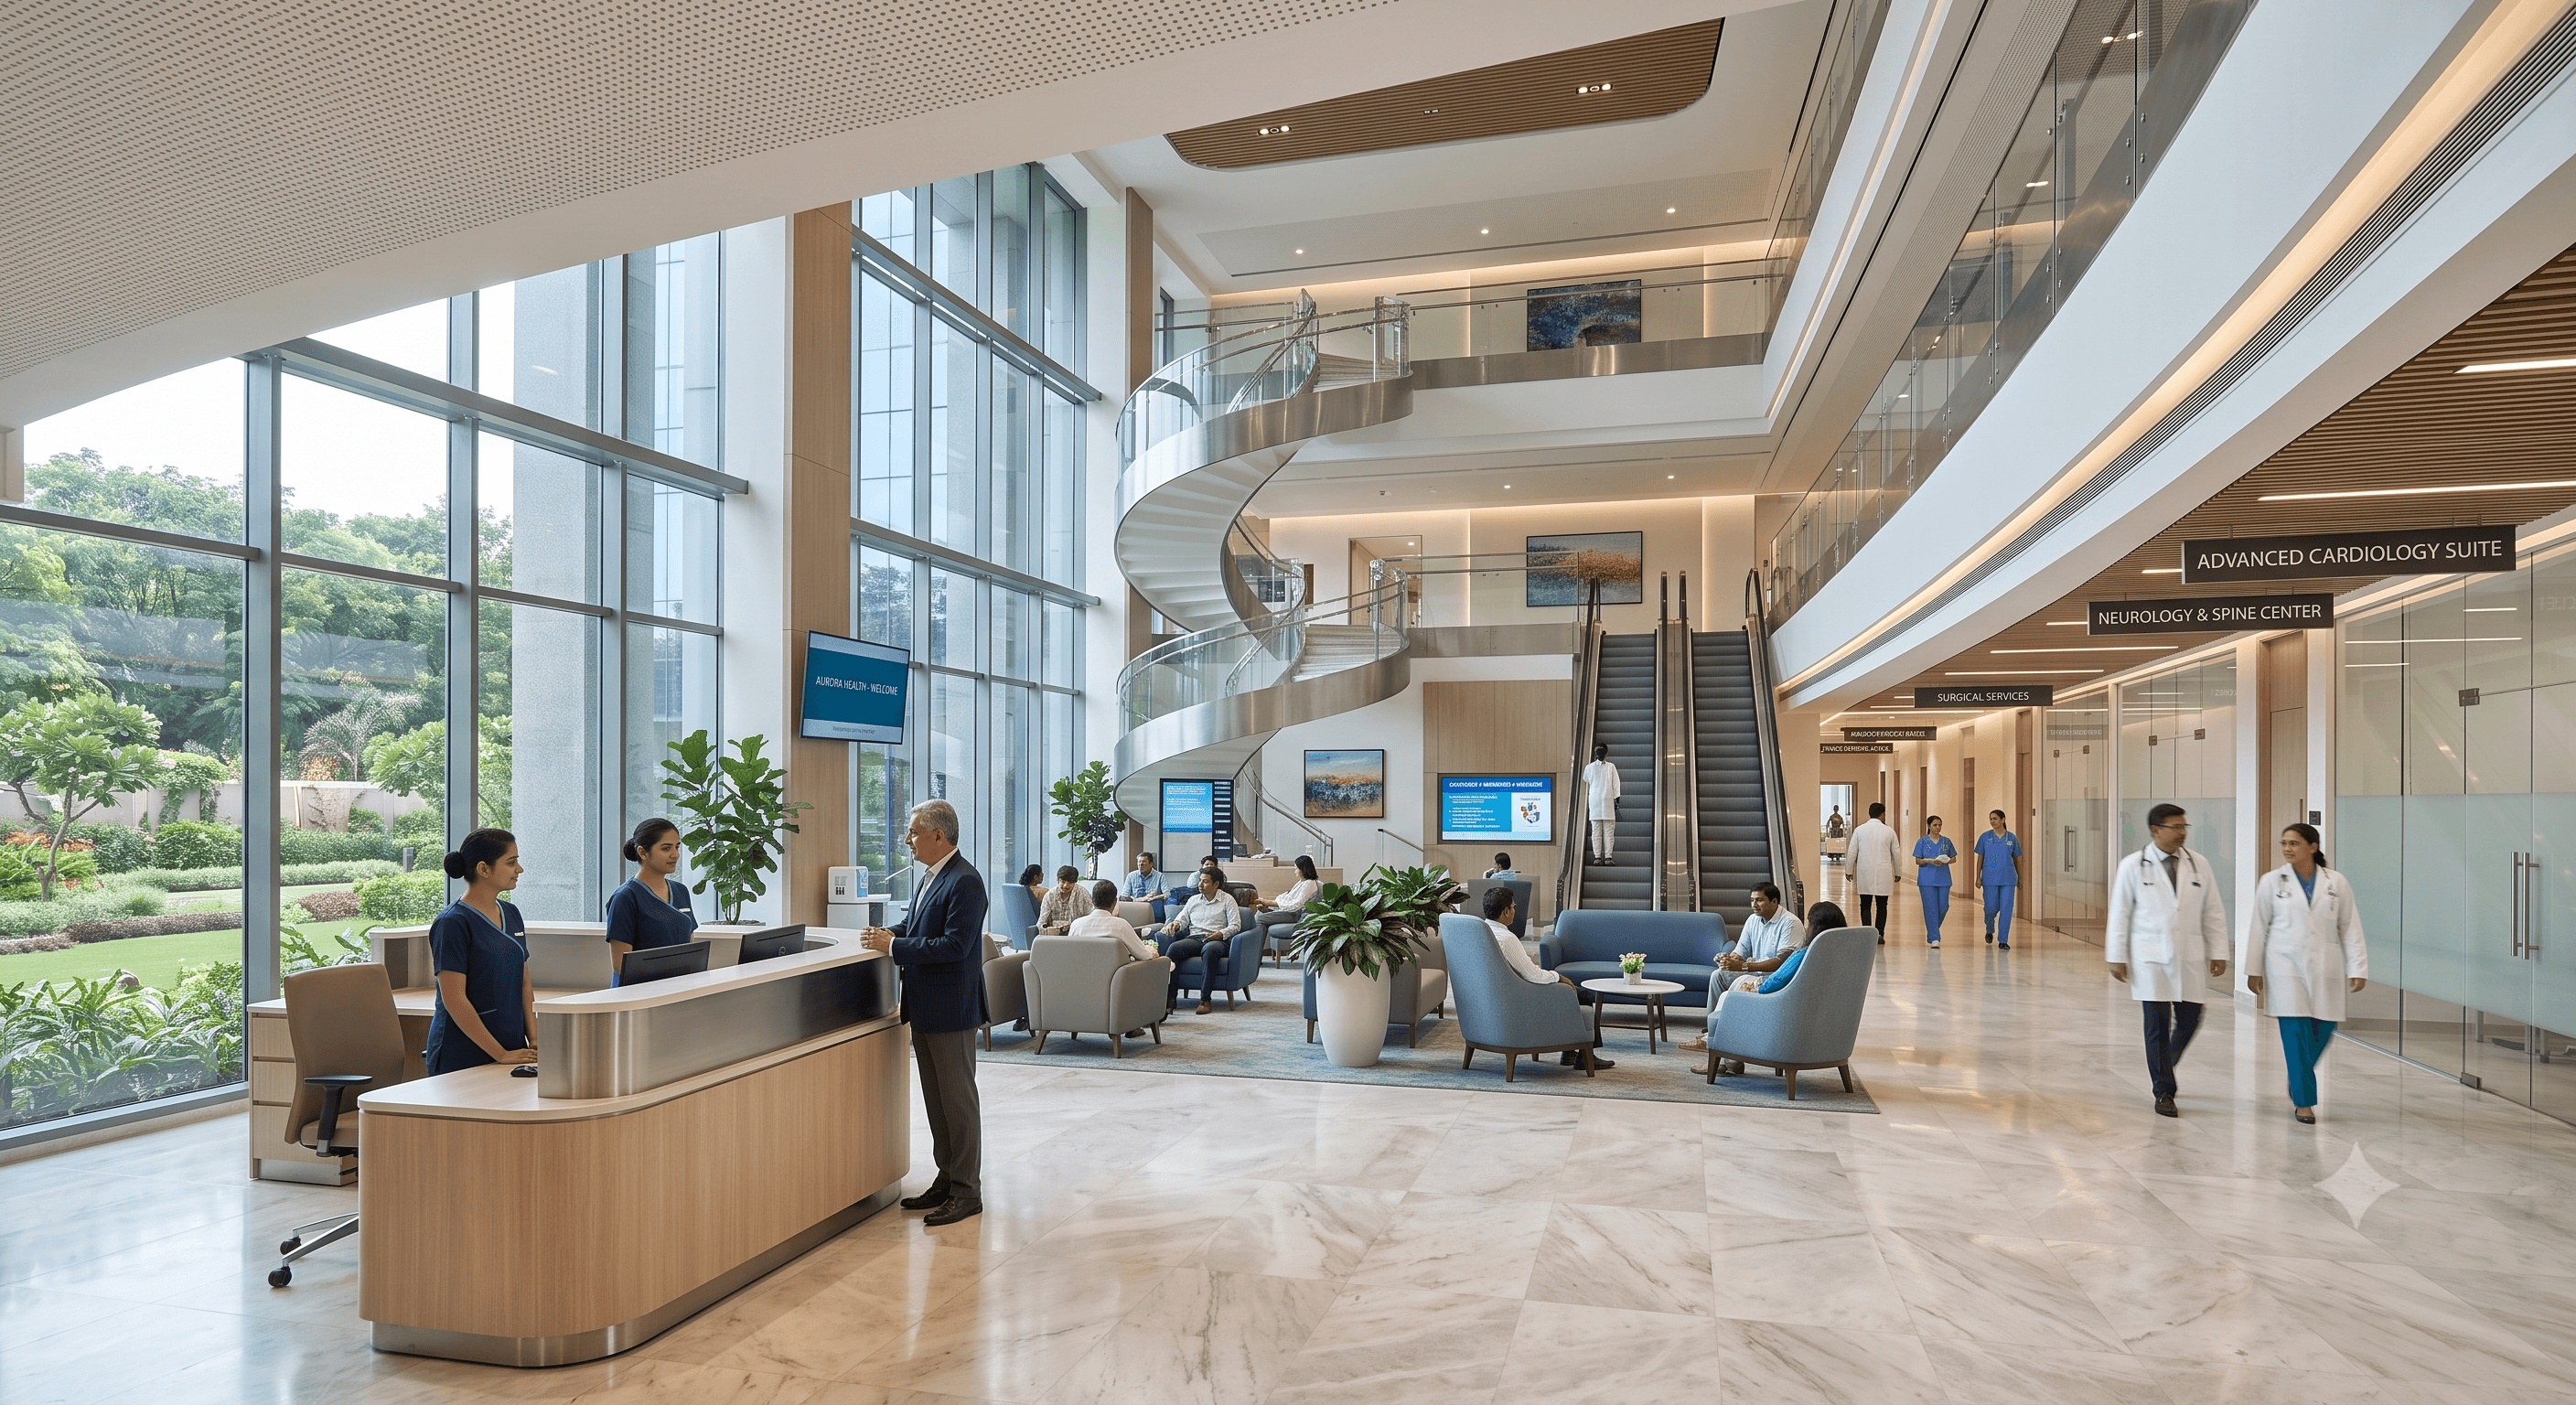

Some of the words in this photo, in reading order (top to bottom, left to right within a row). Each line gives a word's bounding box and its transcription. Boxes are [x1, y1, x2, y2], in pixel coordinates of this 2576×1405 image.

[2197, 549, 2304, 570] ADVANCED
[2309, 542, 2441, 564] CARDIOLOGY
[2445, 540, 2502, 559] SUITE
[2098, 609, 2194, 625] NEUROLOGY
[2196, 608, 2208, 622] &
[2212, 606, 2257, 621] SPINE
[2260, 604, 2322, 619] CENTER
[815, 676, 843, 688] AURORA
[870, 682, 898, 696] WELCOME
[1937, 692, 1985, 702] SURGICAL
[1986, 692, 2030, 702] SERVICES
